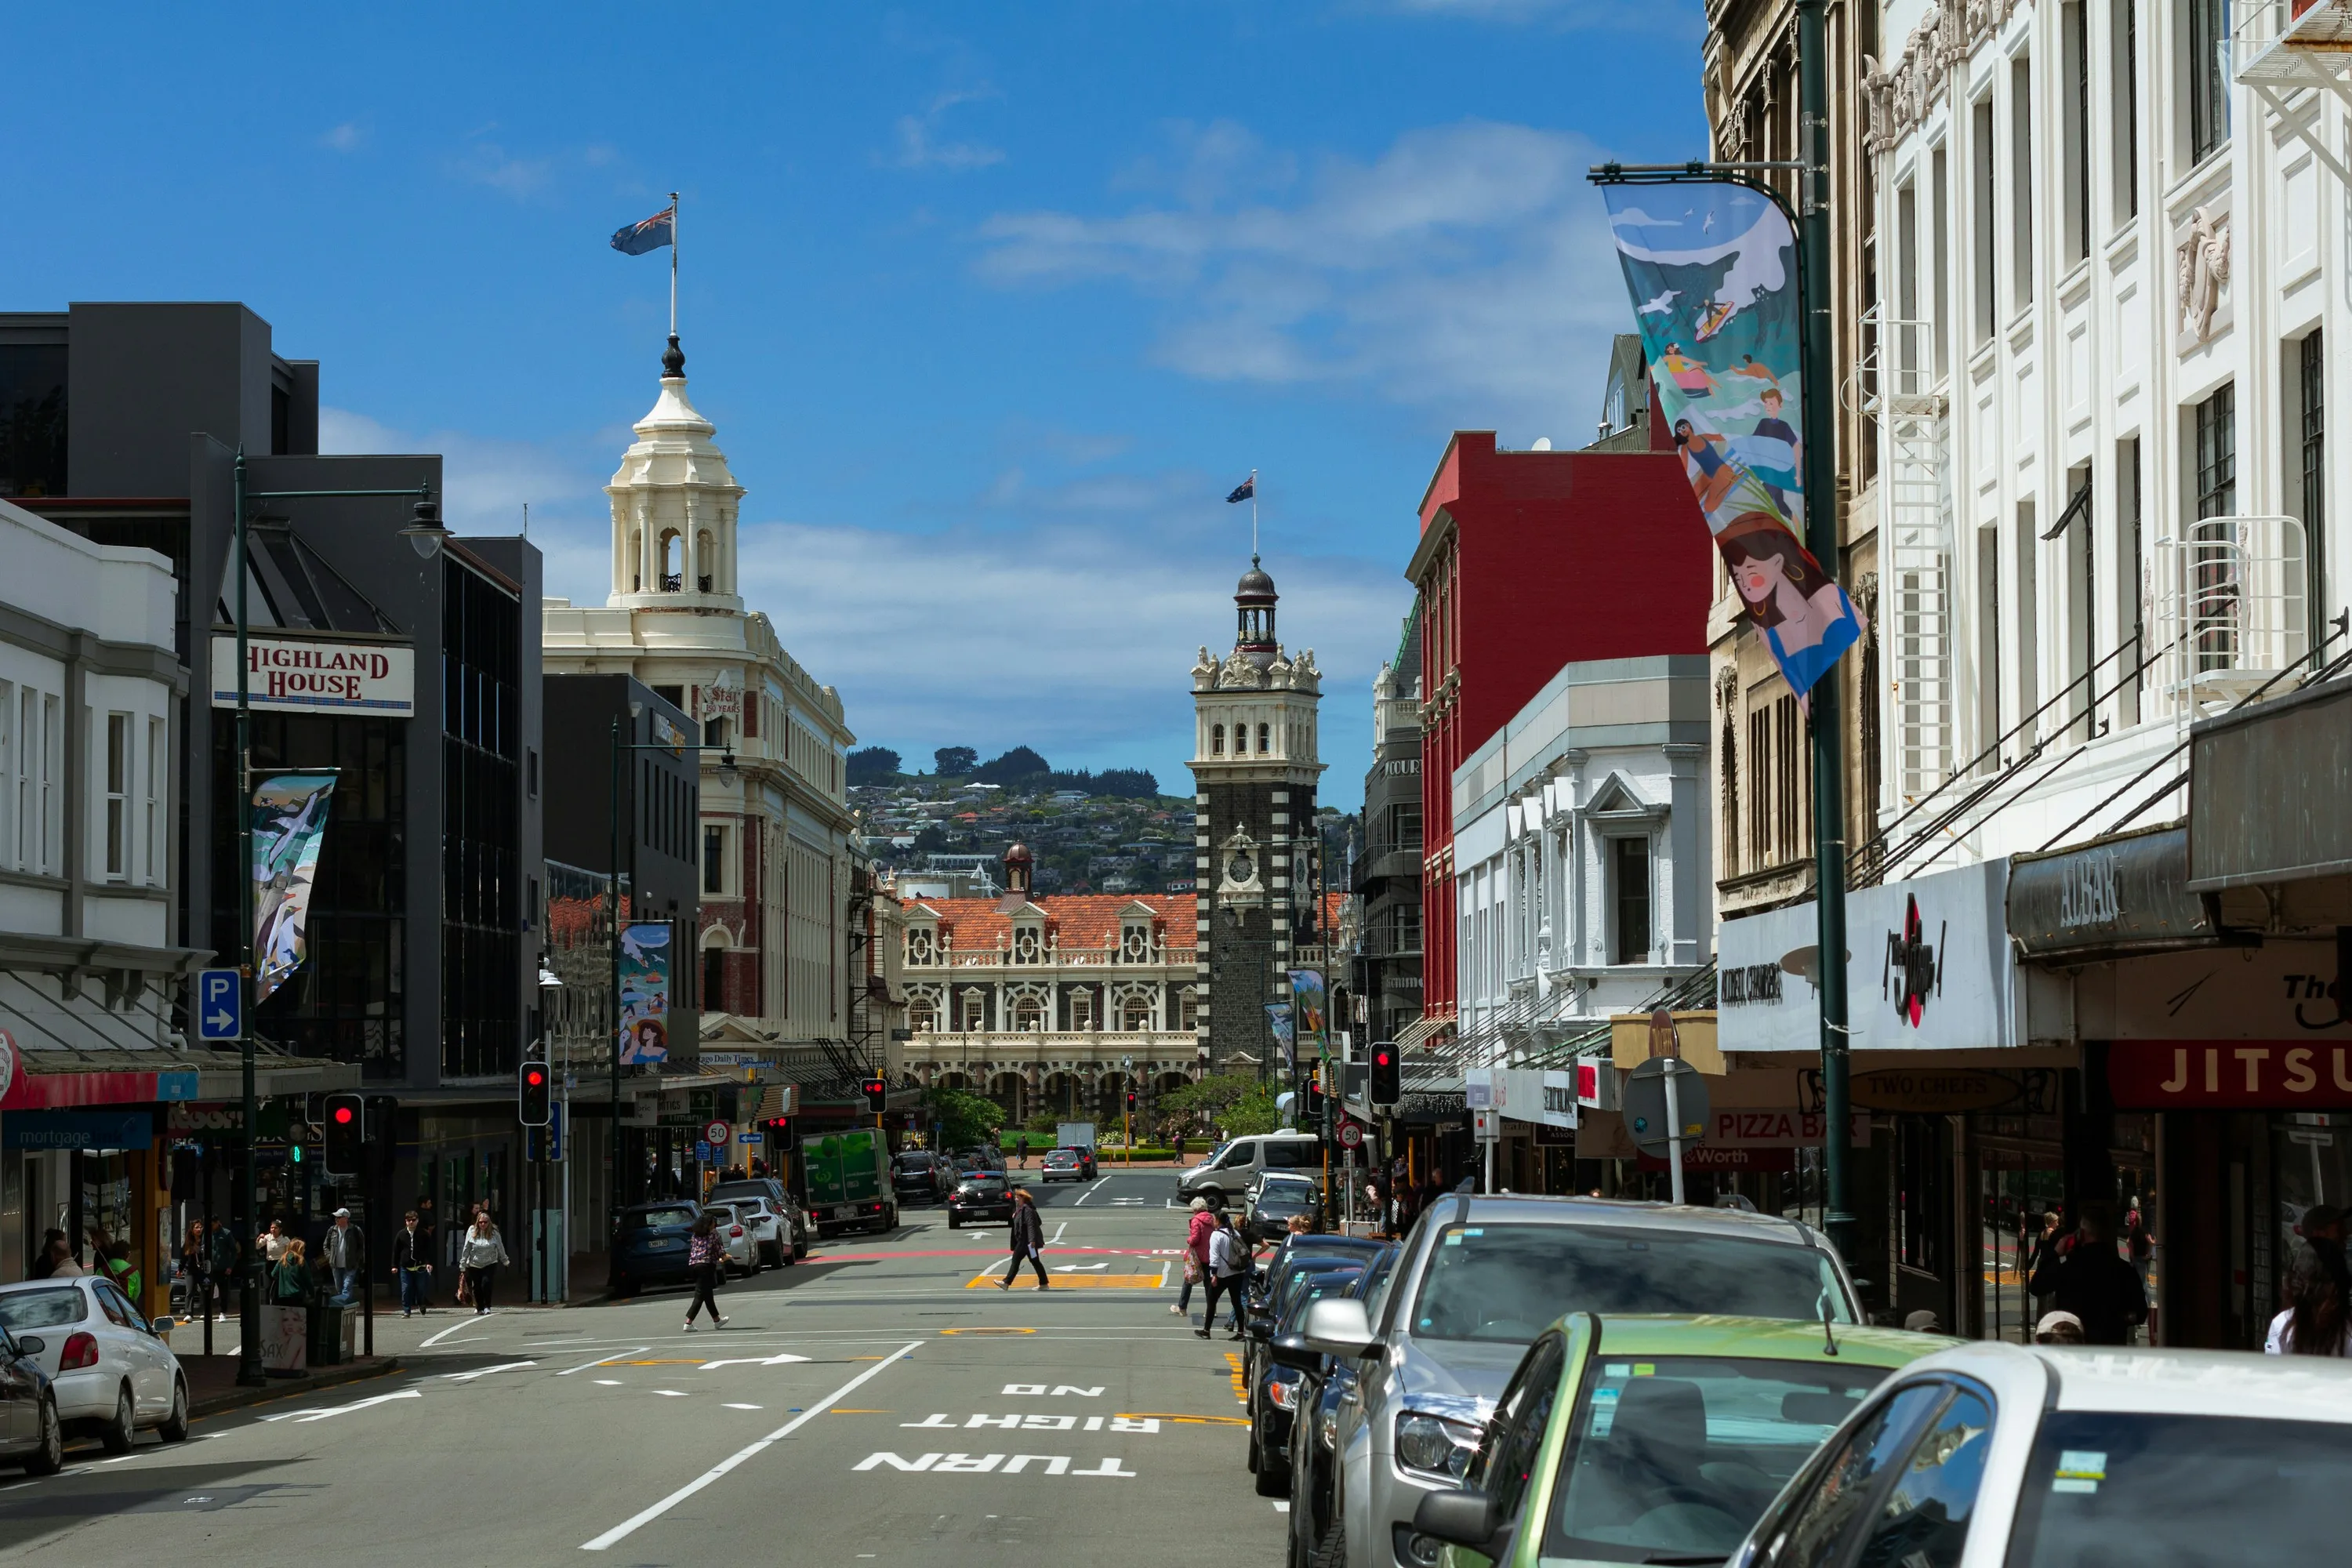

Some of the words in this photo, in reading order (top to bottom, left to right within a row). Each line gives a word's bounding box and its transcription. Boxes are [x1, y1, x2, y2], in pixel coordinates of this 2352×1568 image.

[247, 646, 389, 679] HIGHLAND
[267, 671, 361, 700] HOUSE
[711, 687, 737, 702] Star
[718, 705, 740, 713] YEARS
[2060, 851, 2119, 927] ALBAR
[210, 979, 228, 1002] P
[714, 1054, 731, 1064] Daily
[733, 1054, 753, 1063] Times
[1867, 1074, 1913, 1094] TWO
[1920, 1076, 1987, 1094] CHEFS
[710, 1128, 724, 1138] 50
[1719, 1114, 1793, 1138] PIZZA
[1345, 1131, 1358, 1141] 50
[1001, 1384, 1105, 1396] NO
[899, 1414, 1160, 1433] RIGHT
[851, 1452, 1137, 1477] TURN
